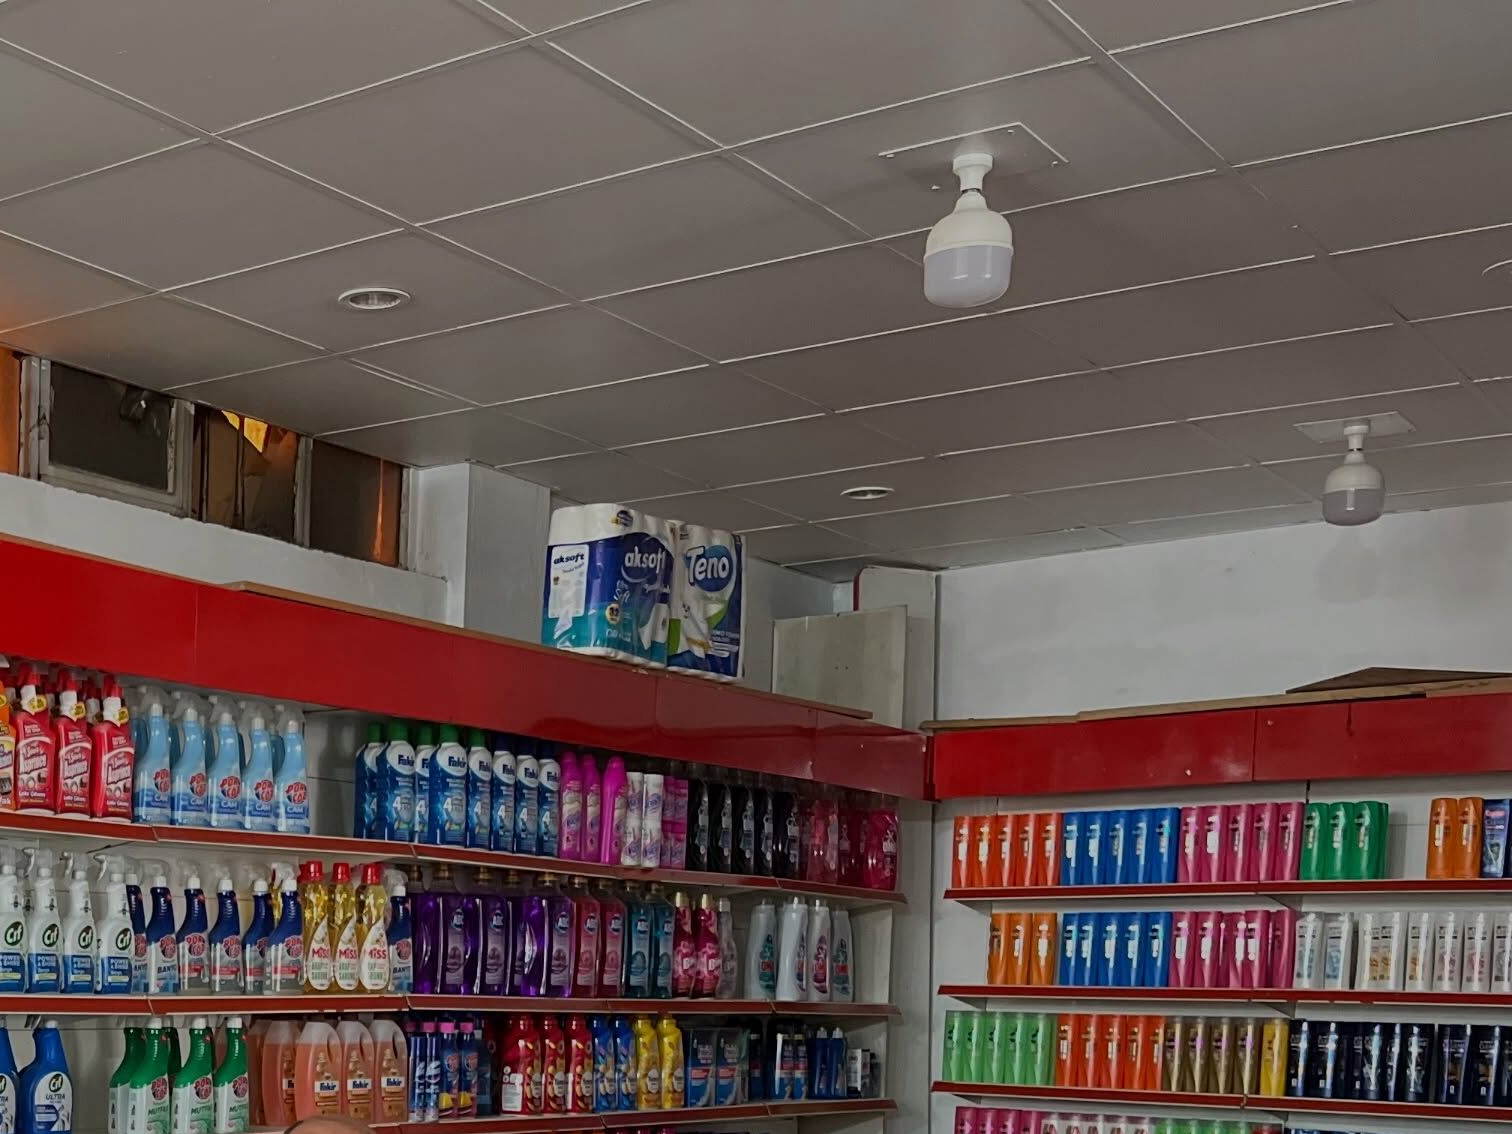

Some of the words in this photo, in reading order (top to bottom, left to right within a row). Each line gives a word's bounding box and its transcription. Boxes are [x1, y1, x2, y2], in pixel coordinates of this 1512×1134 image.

[553, 552, 585, 565] aksoft
[687, 546, 730, 586] Teno
[6, 925, 23, 944] Cif
[117, 931, 131, 948] Cif
[50, 1075, 63, 1092] Cif
